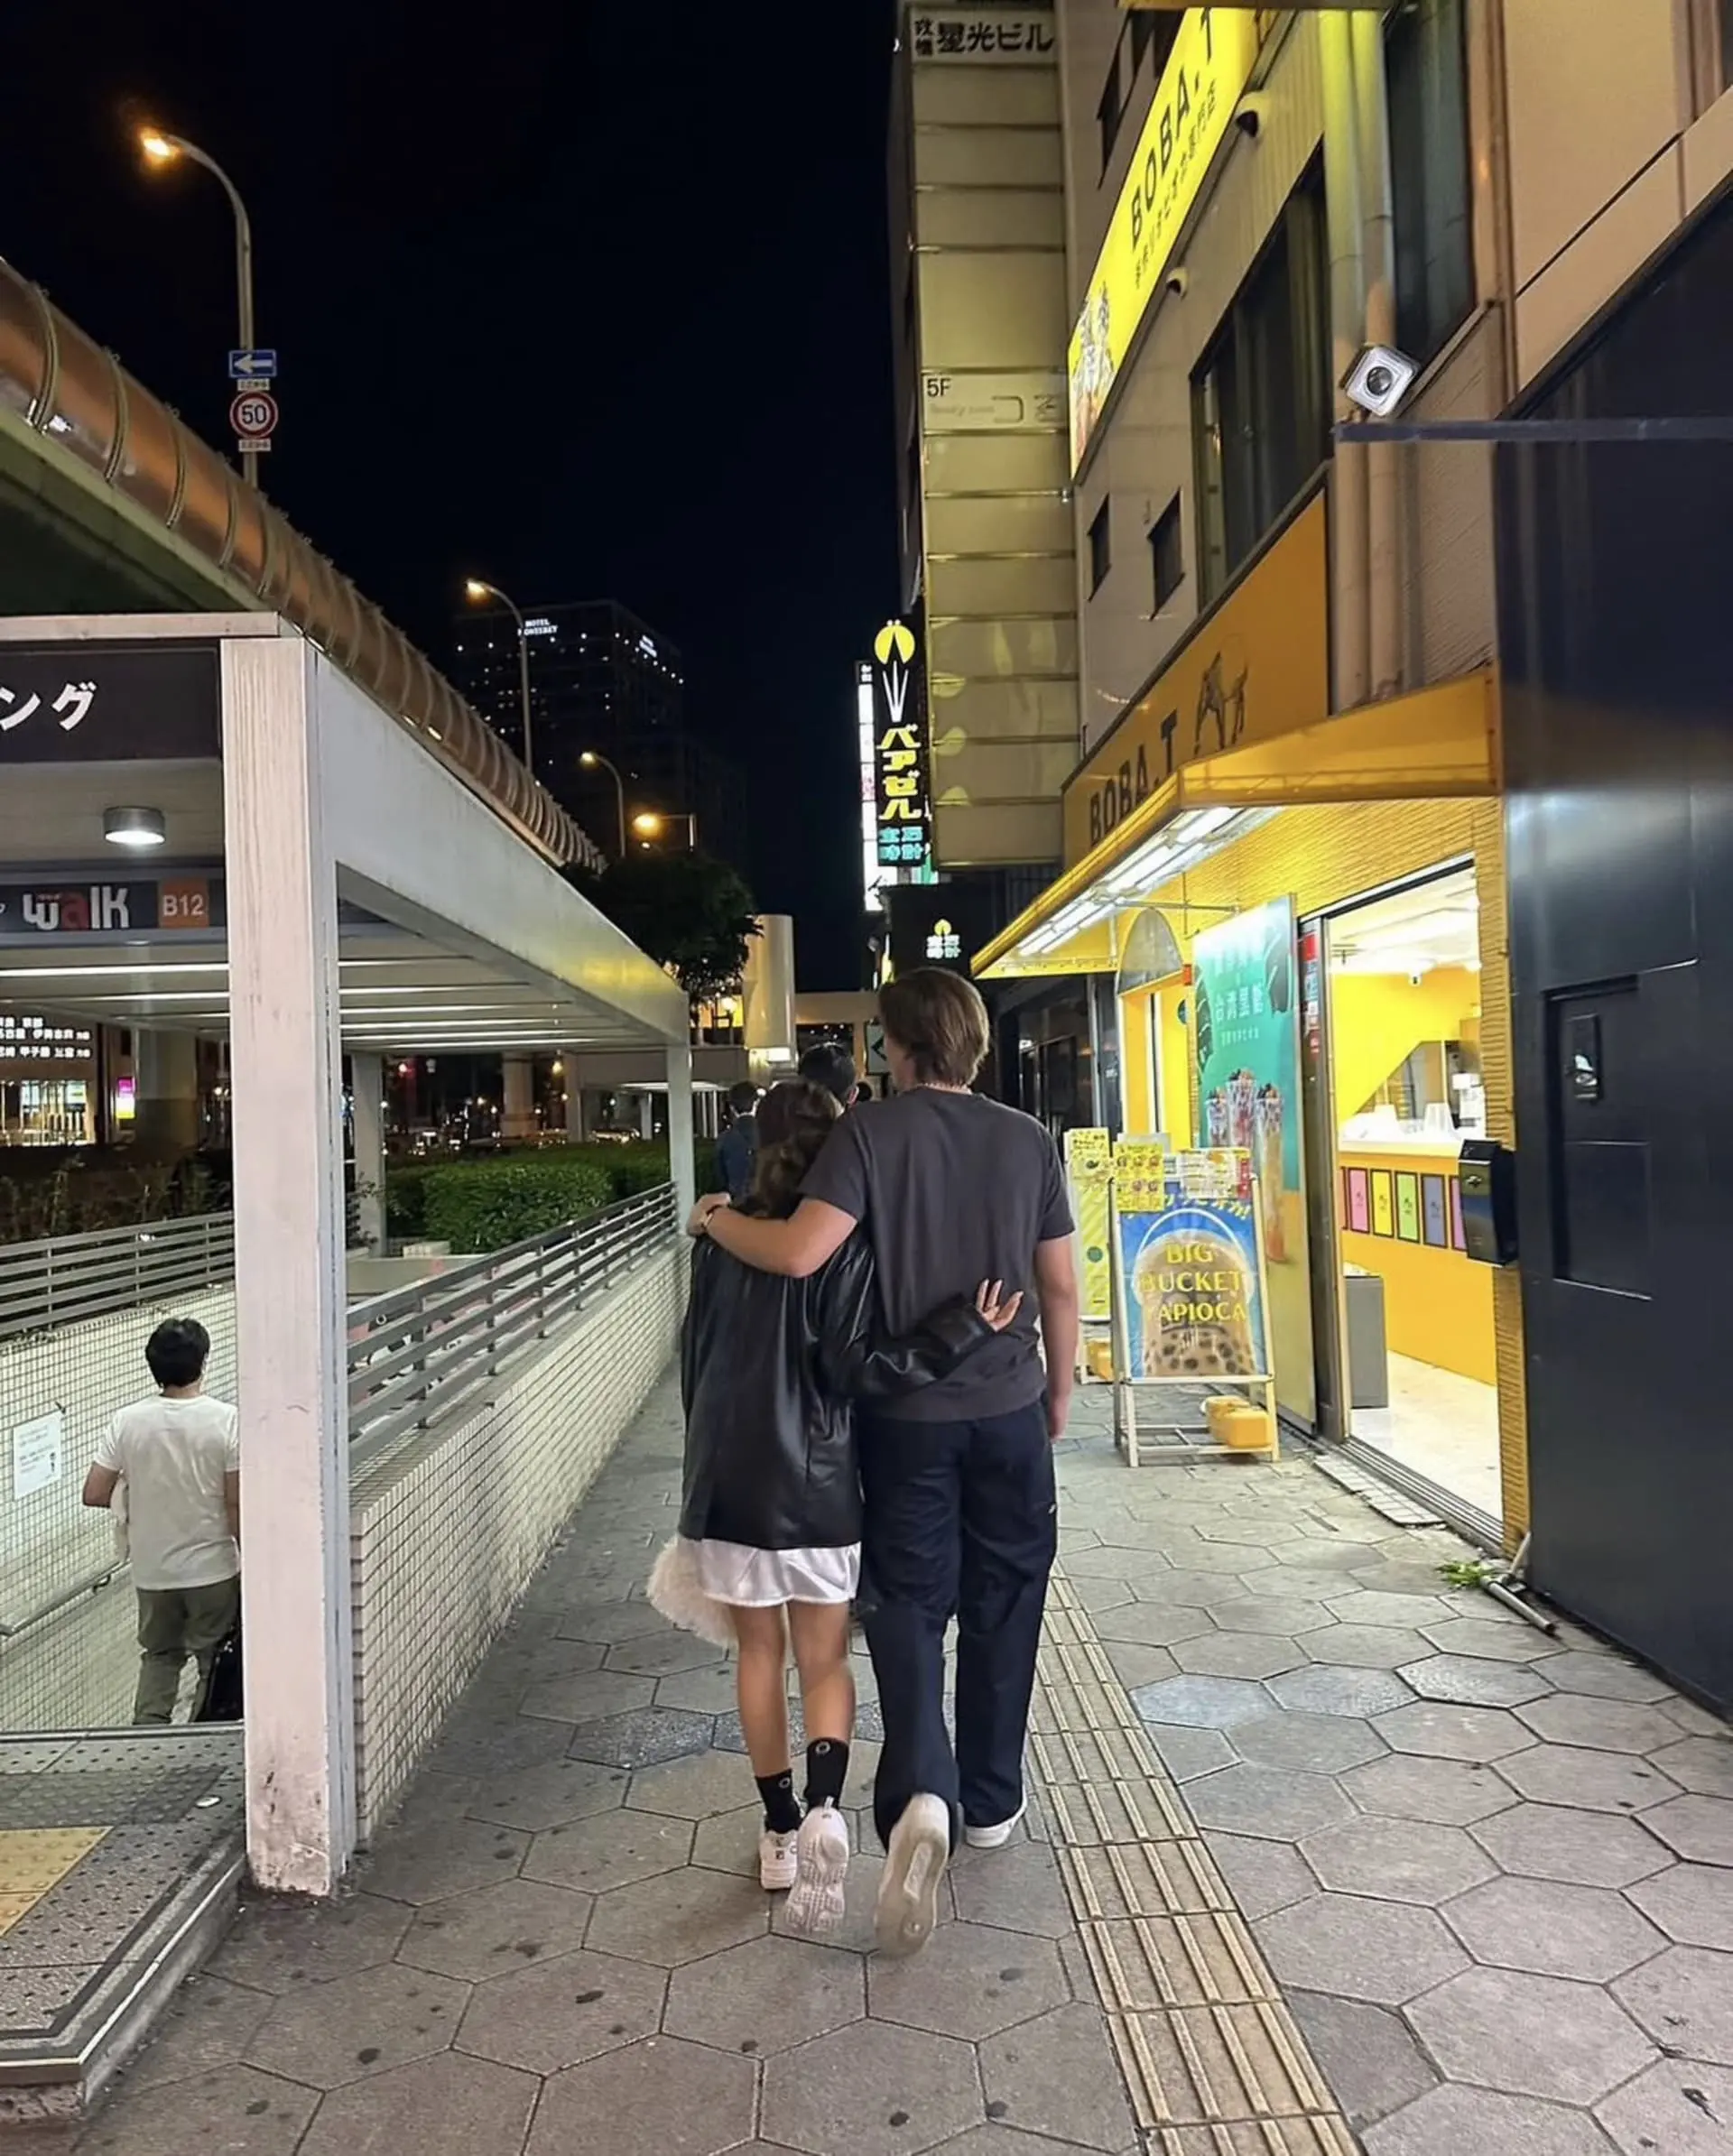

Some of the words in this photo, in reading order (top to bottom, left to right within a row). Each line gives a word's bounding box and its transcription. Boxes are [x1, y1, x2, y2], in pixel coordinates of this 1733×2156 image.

[927, 378, 951, 397] 5F
[241, 403, 268, 425] 50
[0, 681, 97, 732] ング
[23, 885, 129, 931] walk
[162, 894, 205, 917] B12
[1166, 1245, 1214, 1263] BIG
[1140, 1271, 1240, 1292] BUCKET
